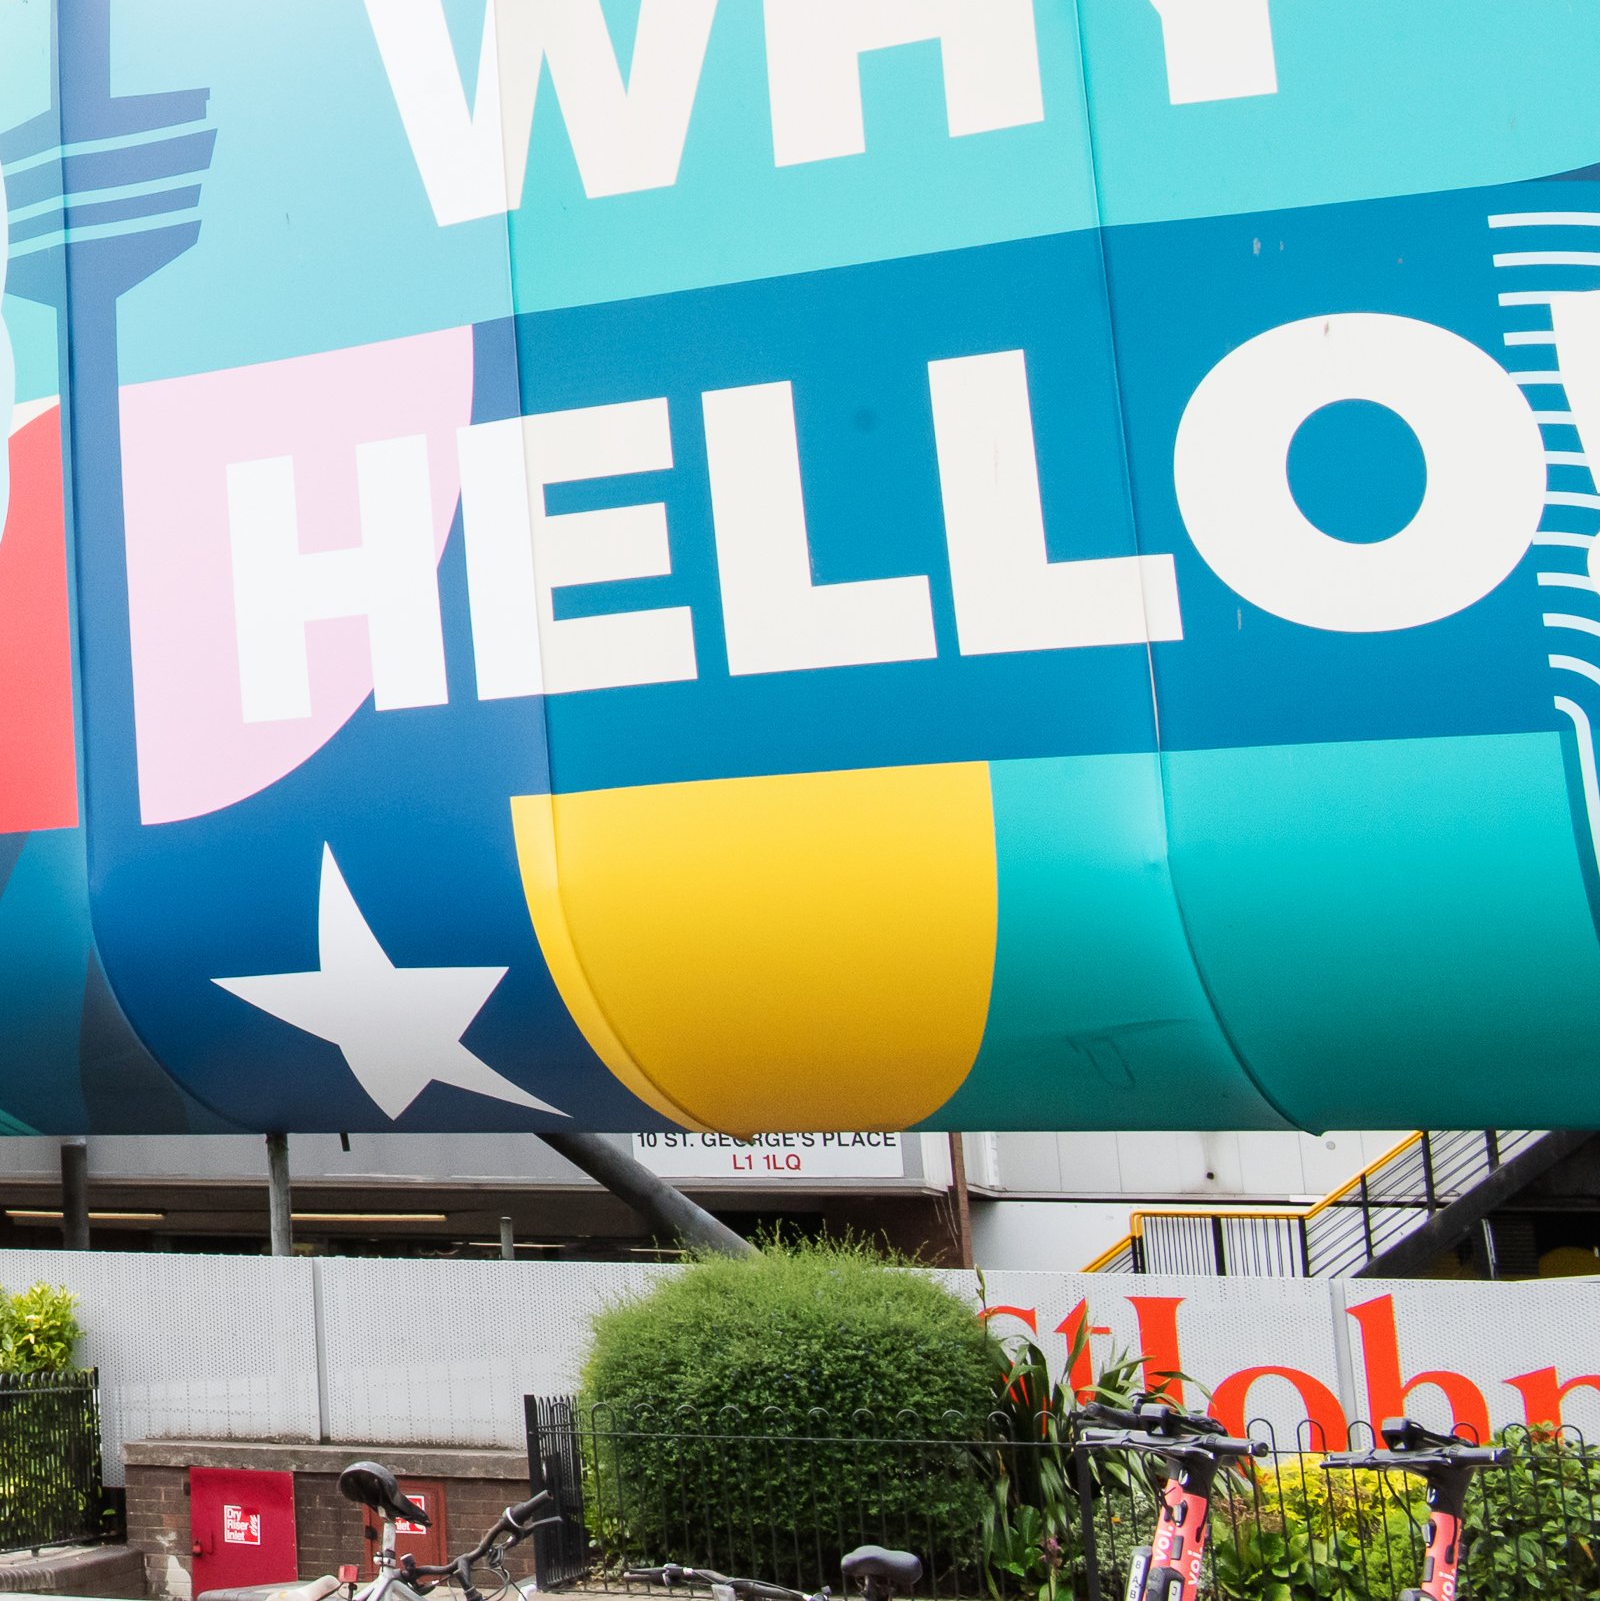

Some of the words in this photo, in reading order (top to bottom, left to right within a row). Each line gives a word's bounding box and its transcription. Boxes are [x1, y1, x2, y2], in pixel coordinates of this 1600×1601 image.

[225, 312, 1547, 724] HELLO
[637, 1132, 658, 1147] 10
[663, 1132, 695, 1147] ST.
[822, 1132, 898, 1147] PLACE
[732, 1154, 753, 1170] L1
[763, 1153, 802, 1170] 1LQ
[227, 1507, 242, 1521] Dry
[227, 1519, 249, 1530] Riser
[395, 1519, 411, 1531] nlet
[226, 1530, 245, 1541] Inlet
